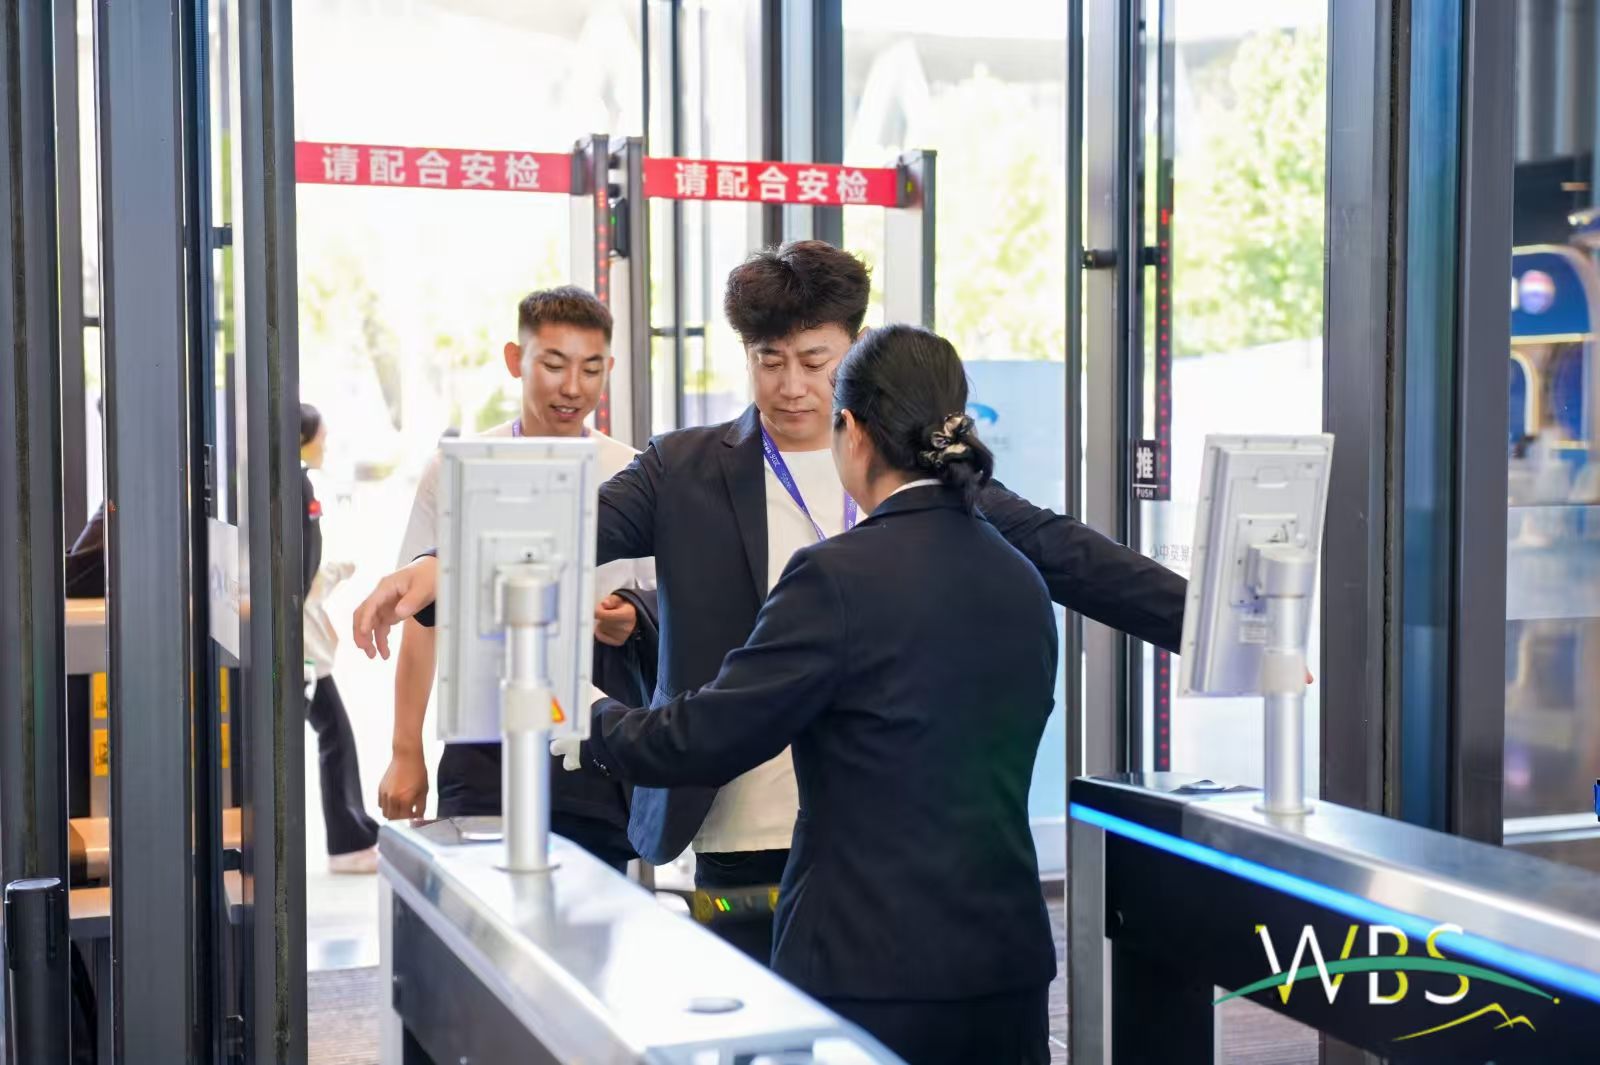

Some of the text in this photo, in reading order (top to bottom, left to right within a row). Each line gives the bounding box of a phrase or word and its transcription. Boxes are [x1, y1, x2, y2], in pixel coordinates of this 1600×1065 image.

[322, 146, 540, 189] 请配合安检
[674, 162, 868, 203] 请配合安检
[1136, 447, 1153, 478] 推
[1136, 488, 1154, 497] PUSH
